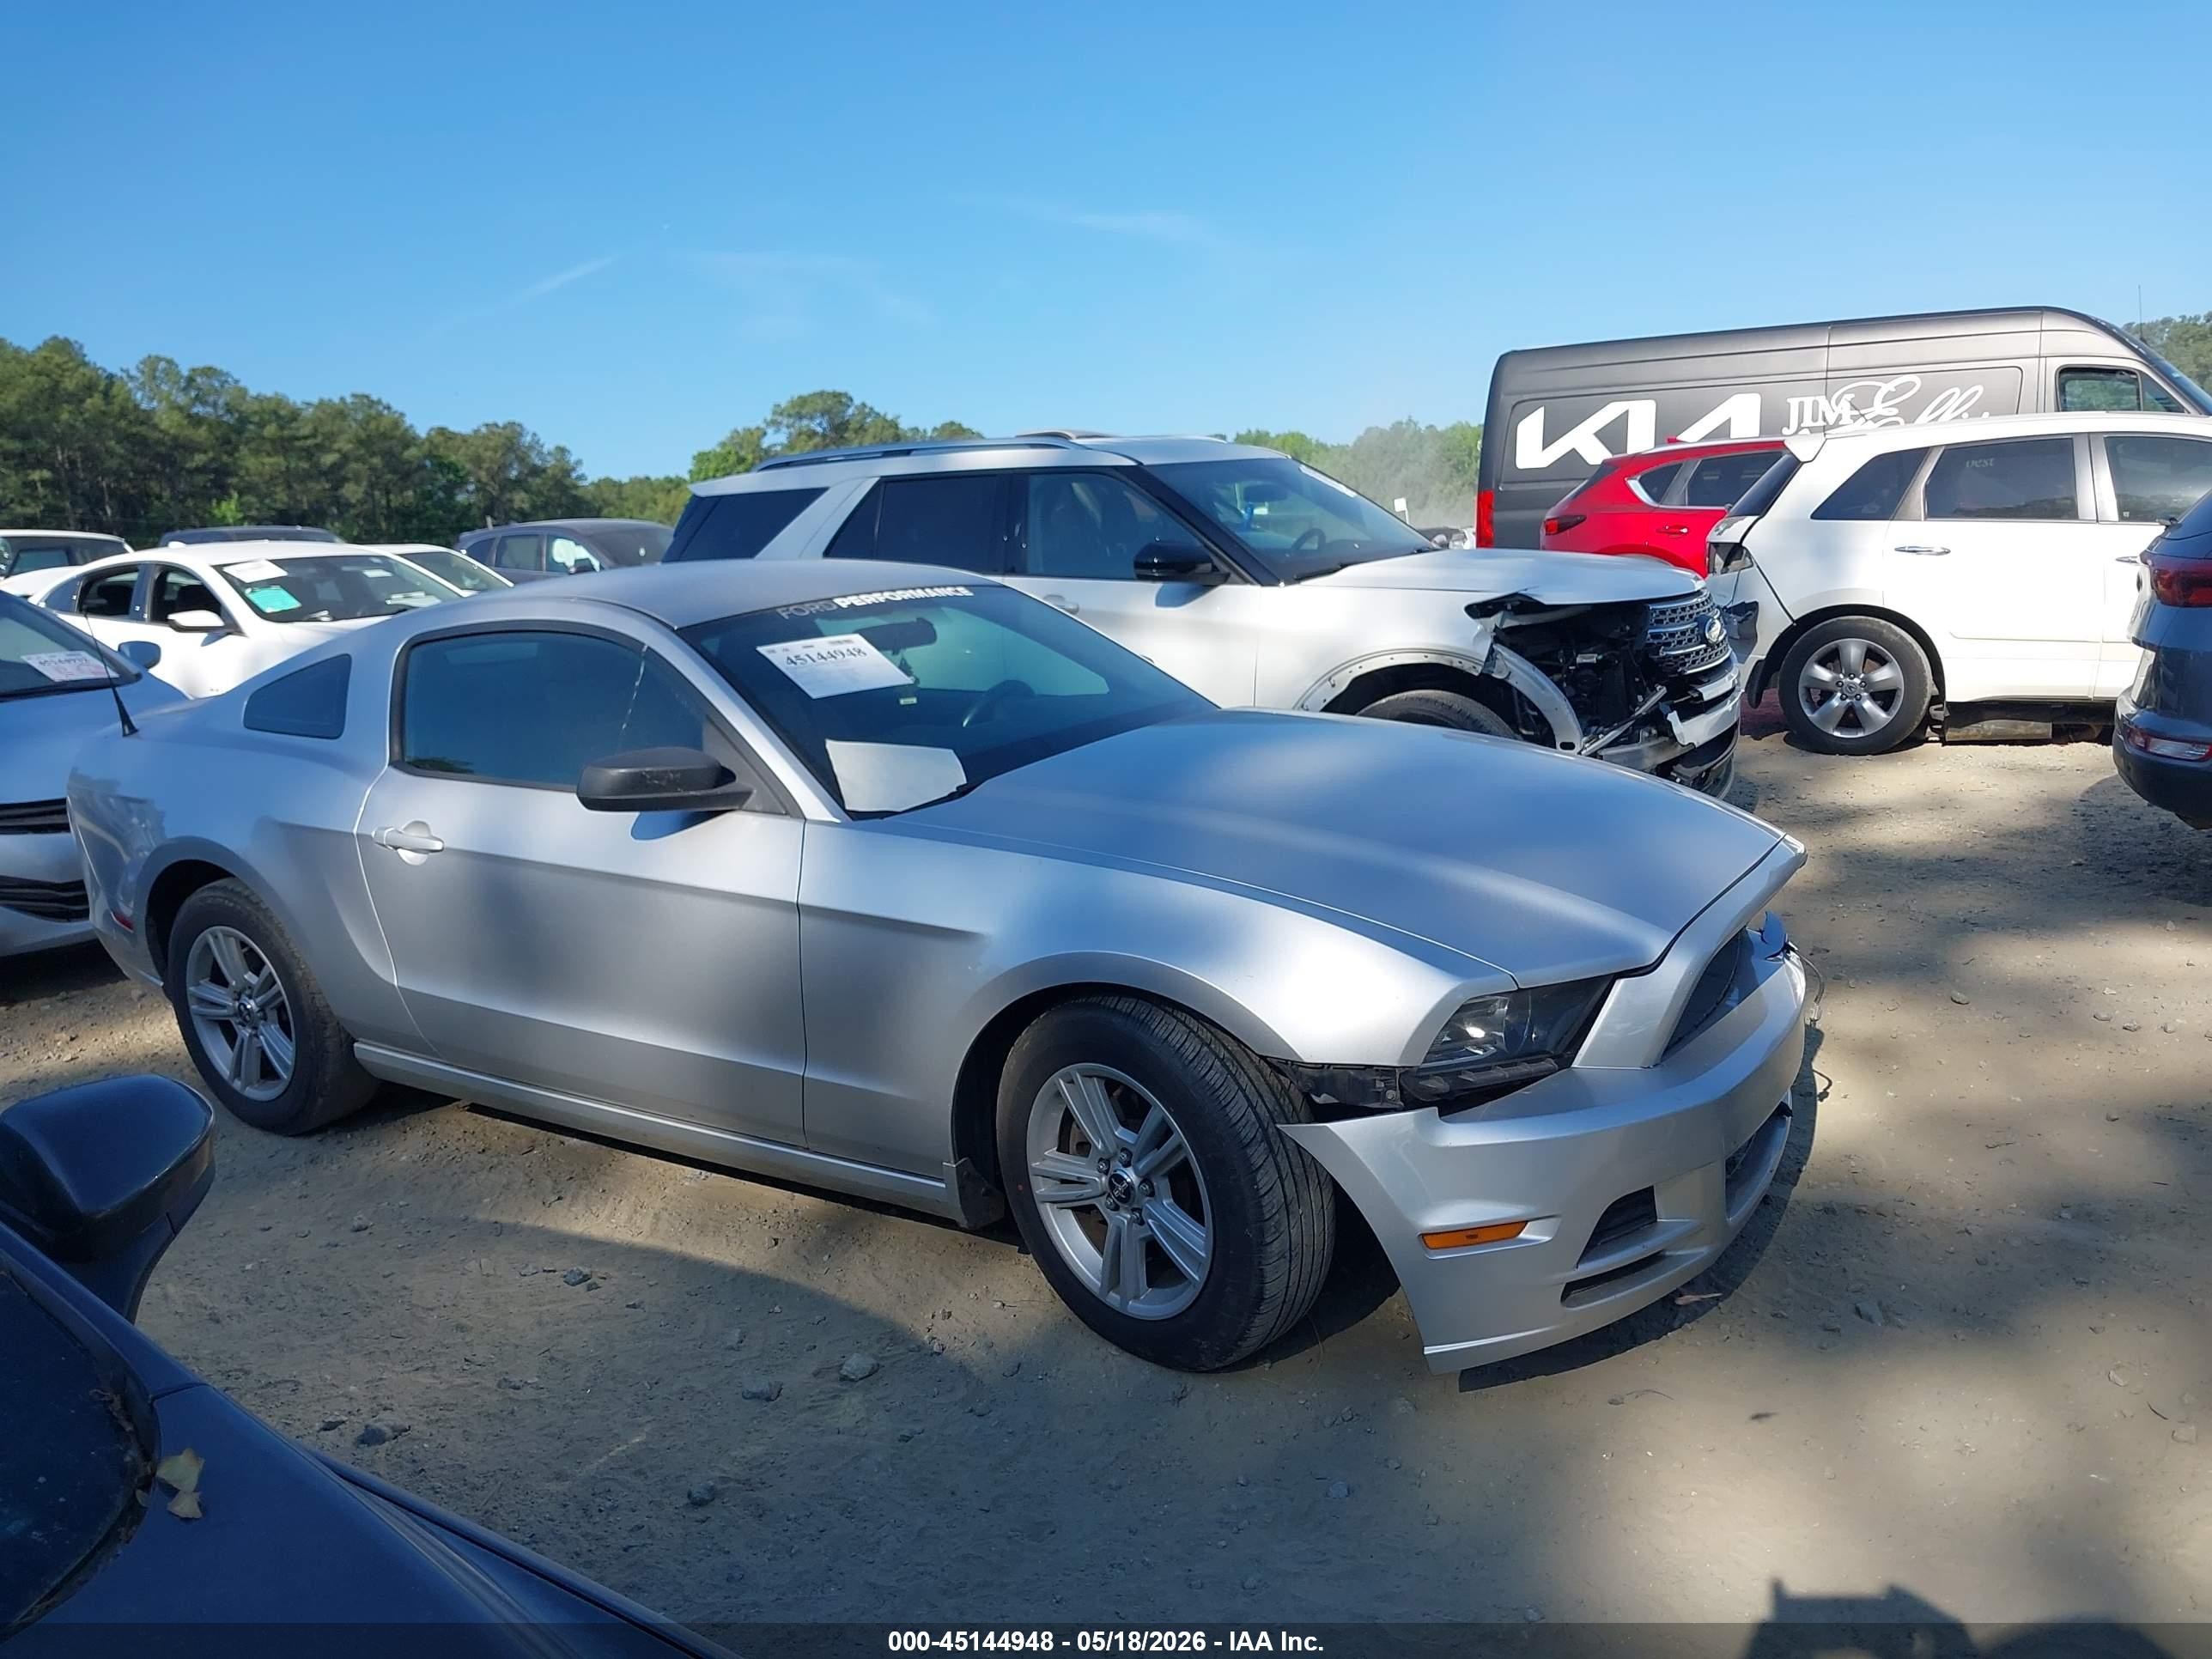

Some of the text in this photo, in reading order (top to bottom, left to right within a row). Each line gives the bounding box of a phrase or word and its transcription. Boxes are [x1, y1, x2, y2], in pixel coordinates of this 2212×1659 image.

[1516, 392, 1761, 470] KIA
[1782, 393, 1855, 435] JIM
[786, 647, 867, 666] 45144948
